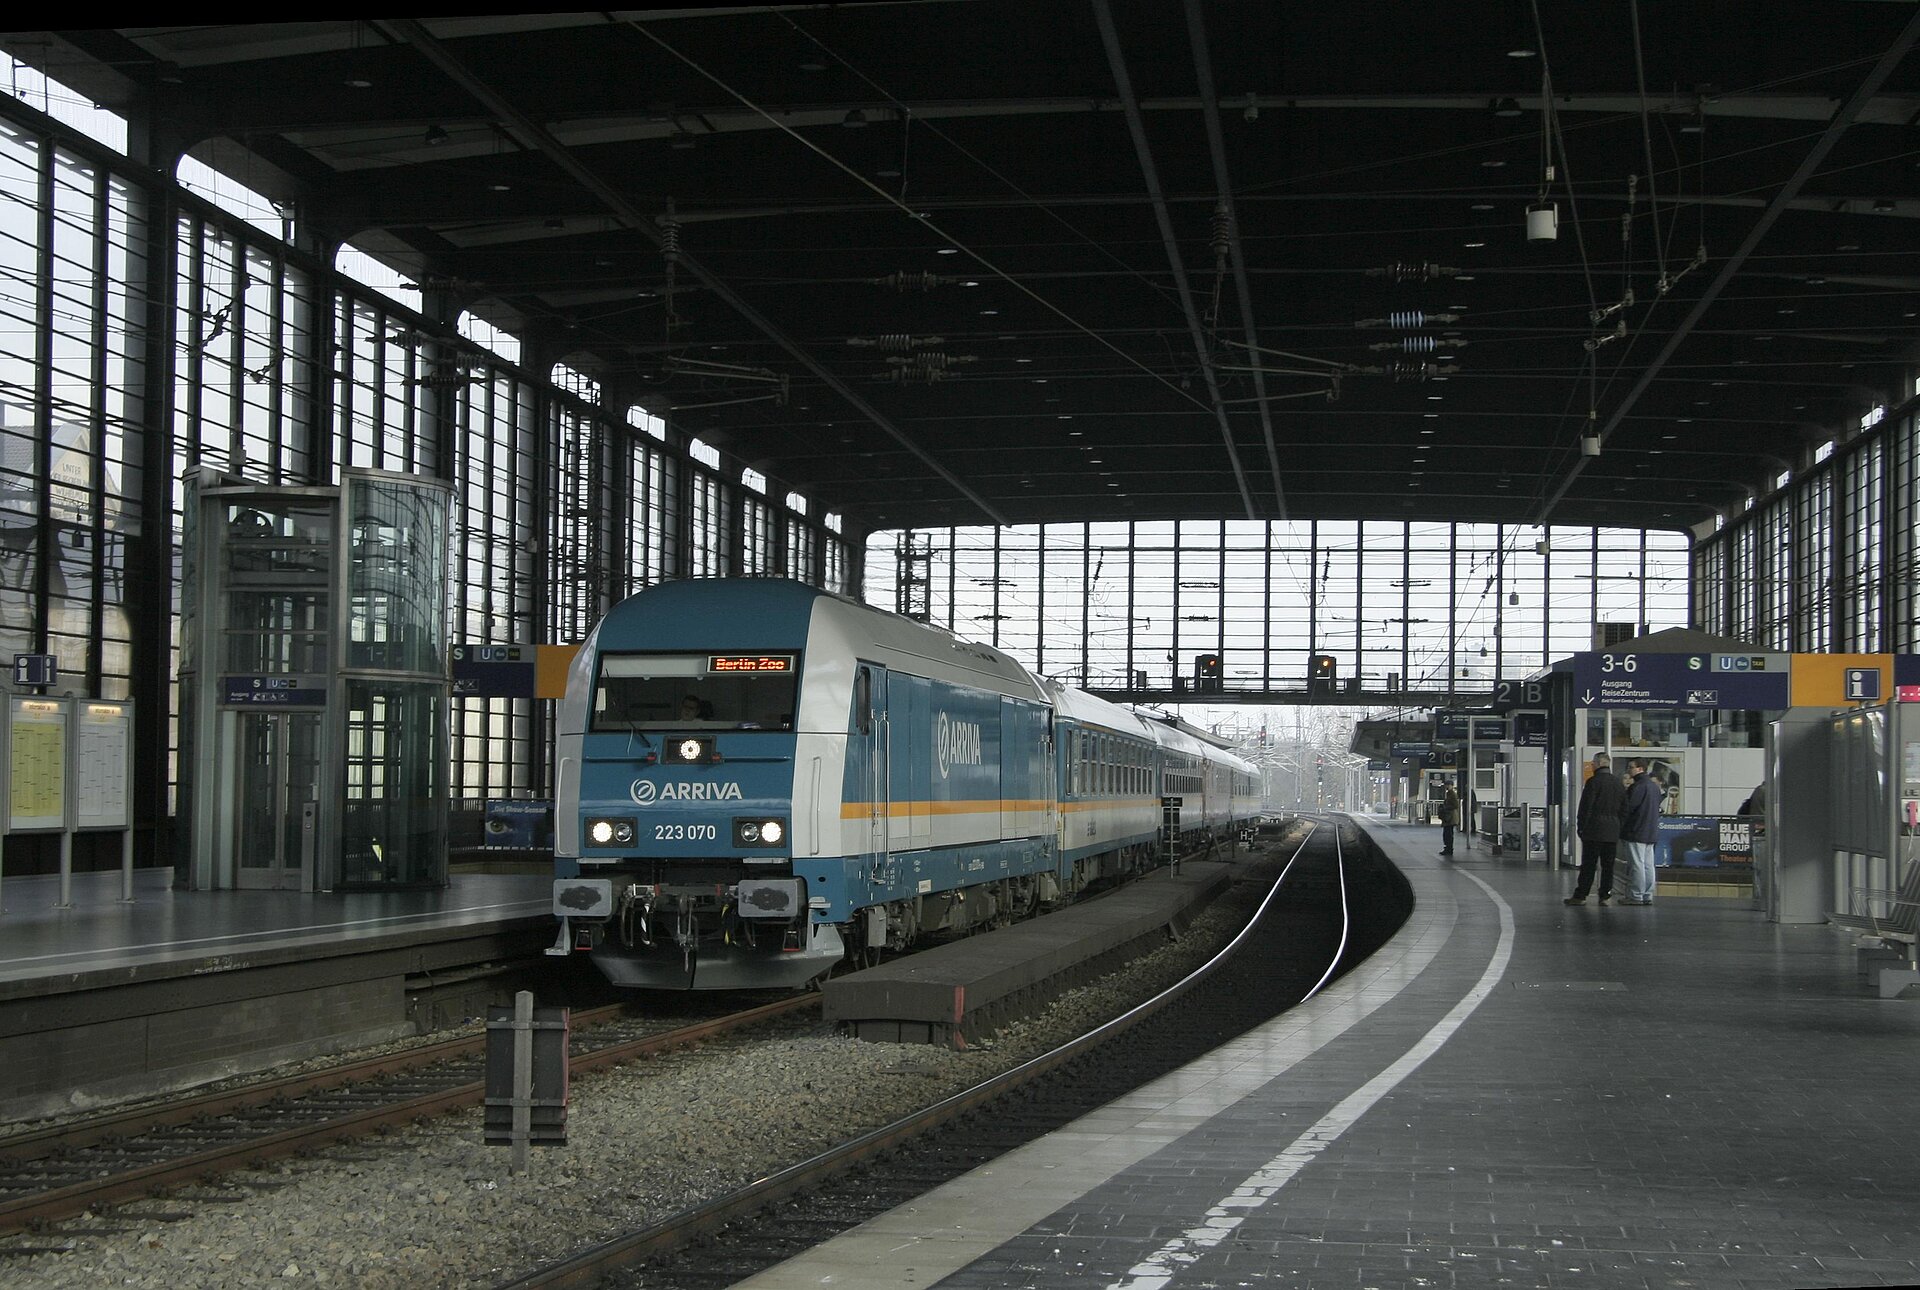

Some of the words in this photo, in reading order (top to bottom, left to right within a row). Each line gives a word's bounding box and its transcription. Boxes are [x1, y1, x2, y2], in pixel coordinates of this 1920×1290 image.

[453, 648, 464, 660] S
[481, 648, 491, 660] U
[715, 658, 756, 670] Berlin
[758, 658, 785, 670] Zoo
[1601, 654, 1637, 673] 3-6
[1689, 657, 1702, 670] S
[1721, 657, 1731, 670] U
[252, 678, 262, 688] S
[271, 679, 278, 688] U
[1601, 680, 1633, 689] Ausgang
[1497, 682, 1511, 703] 2
[1527, 683, 1542, 703] B
[1601, 689, 1650, 697] ReiseZentrum
[1442, 715, 1450, 725] 2
[950, 720, 982, 765] ARRIVA
[1428, 752, 1436, 763] 2
[1443, 753, 1452, 763] C
[659, 782, 743, 800] ARRIVA
[655, 825, 684, 840] 223
[687, 825, 716, 840] 070
[1719, 823, 1750, 834] BLUE
[1240, 830, 1248, 841] H
[1719, 833, 1750, 844] MAN
[1719, 844, 1750, 852] GROUP
[1719, 854, 1747, 863] Theater
